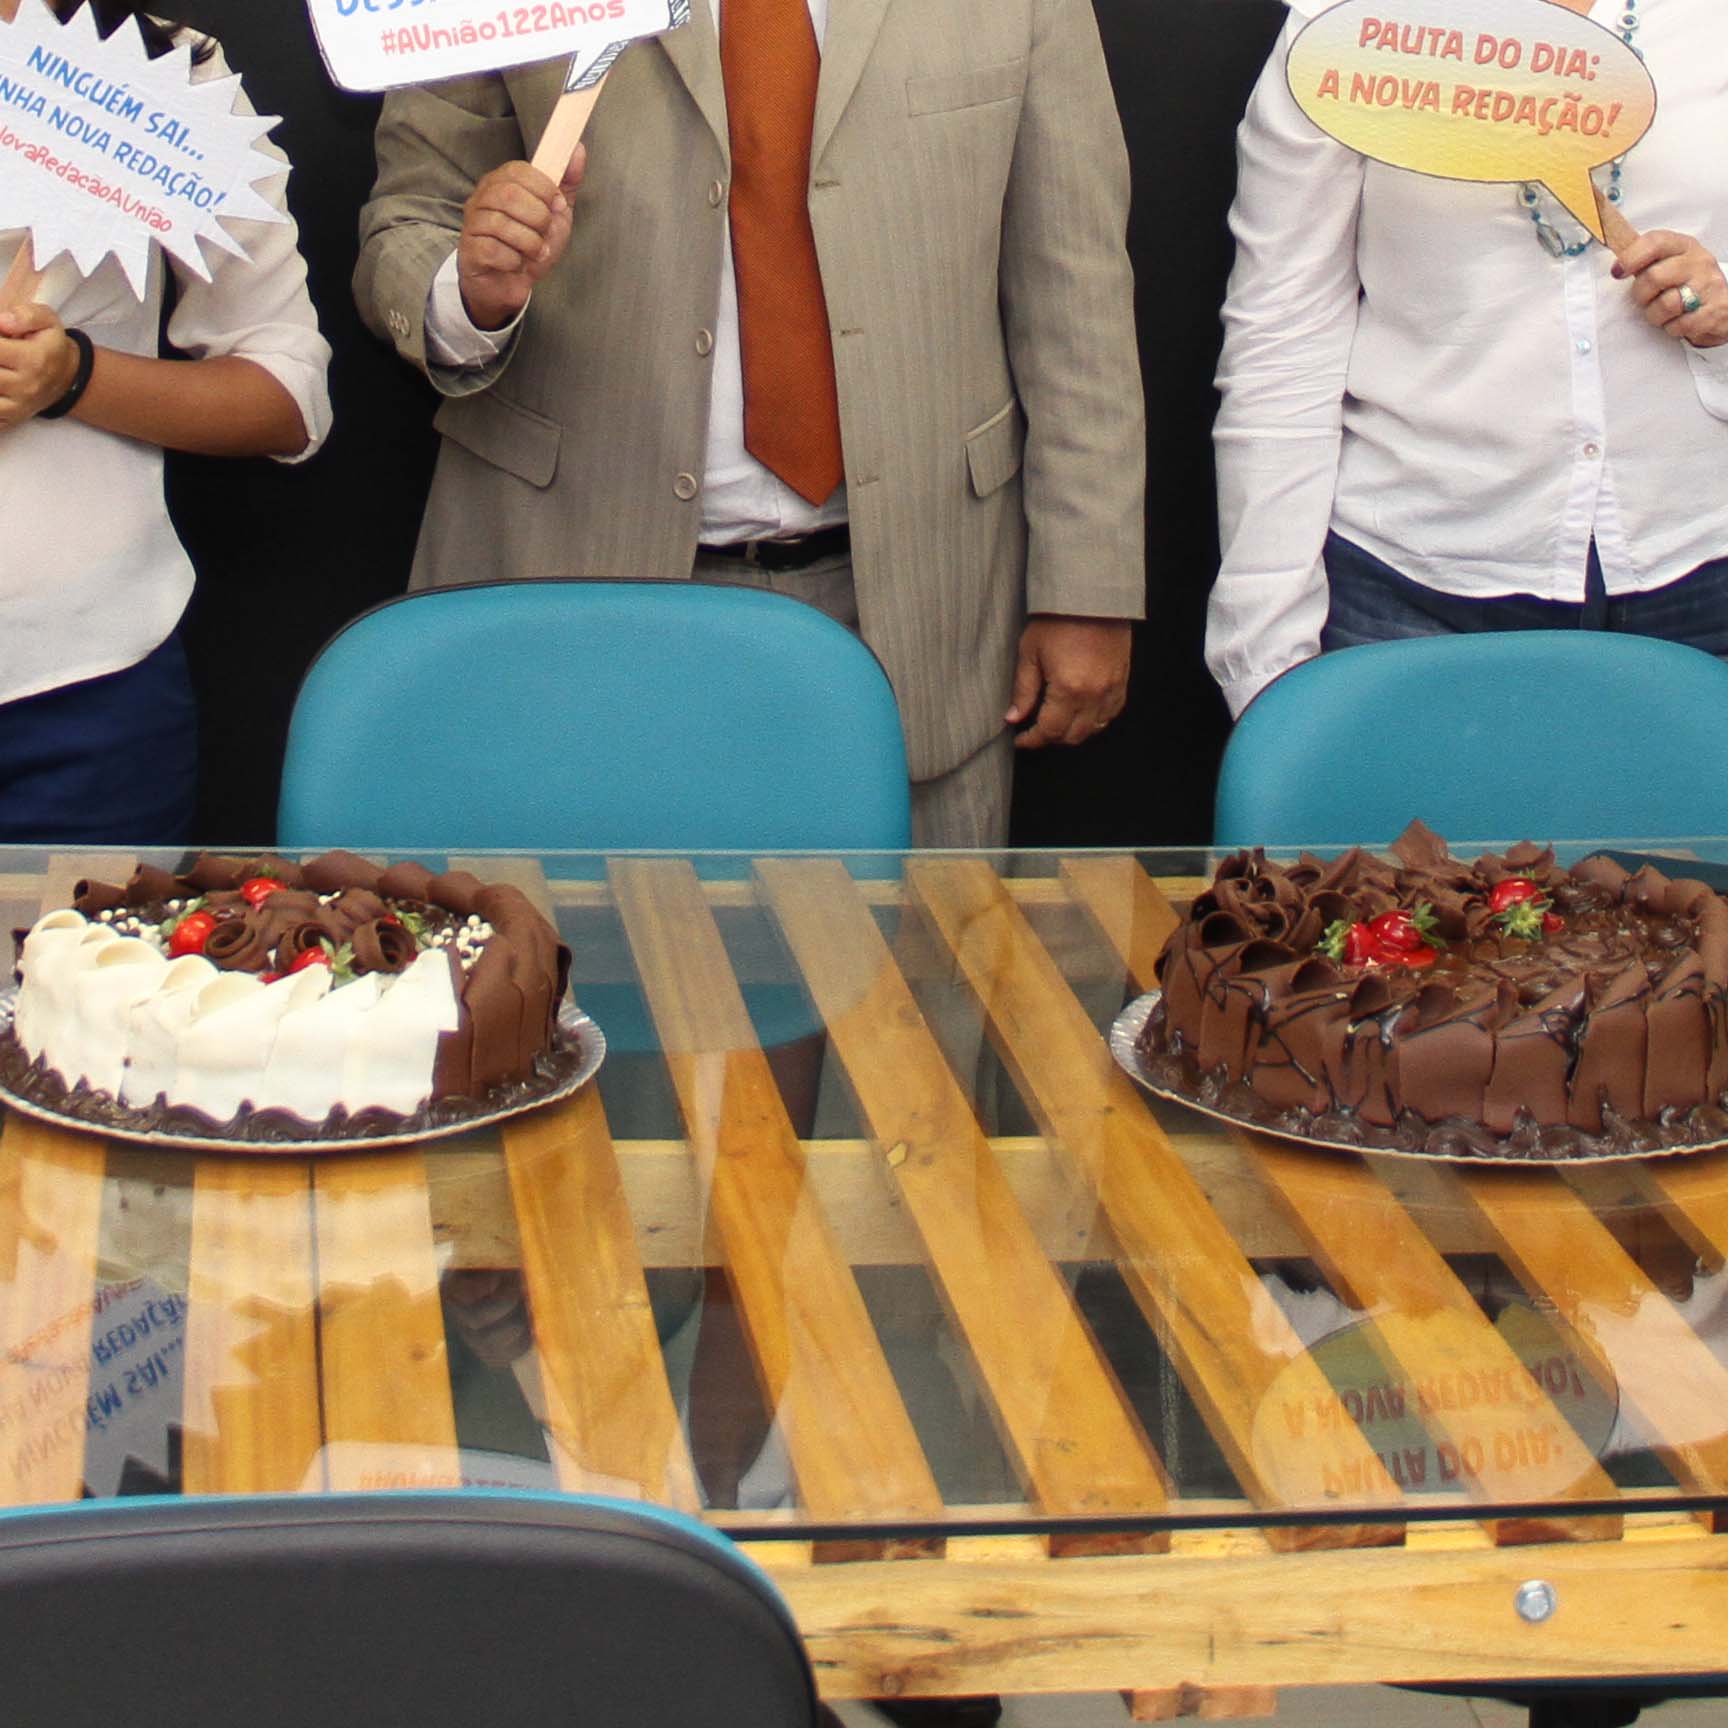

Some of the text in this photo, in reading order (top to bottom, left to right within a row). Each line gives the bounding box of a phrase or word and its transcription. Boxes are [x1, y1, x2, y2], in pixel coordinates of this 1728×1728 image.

[1359, 17, 1601, 82] PAUTA DO DIA:
[26, 44, 205, 161] NINGUÉM SAI...
[1316, 69, 1622, 138] A NOVA REDAÇÃO!
[48, 106, 113, 158] NOVA
[113, 140, 228, 214] REDAÇÃO!
